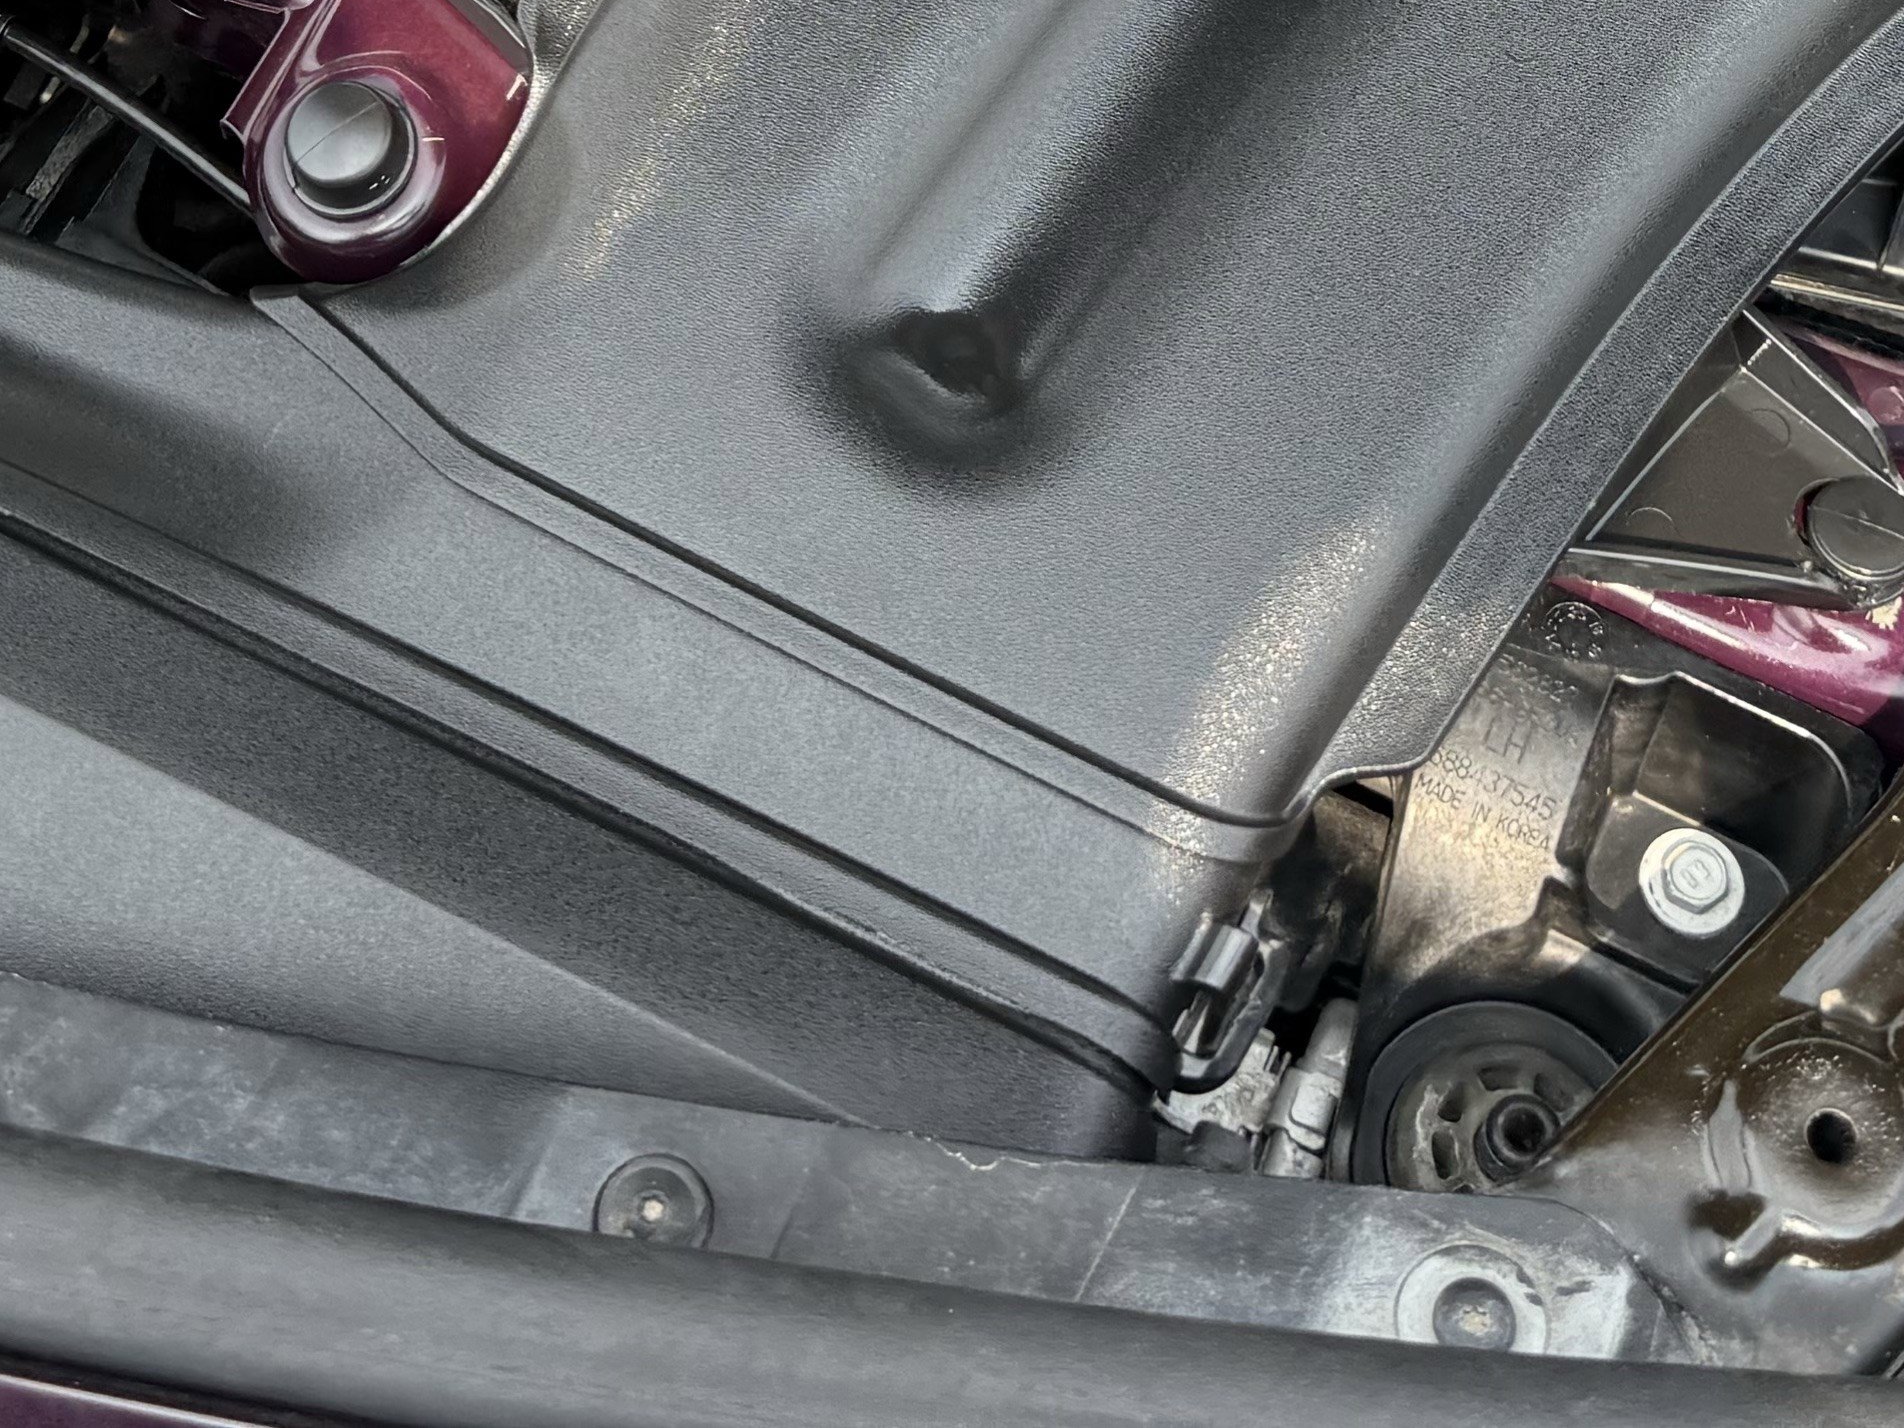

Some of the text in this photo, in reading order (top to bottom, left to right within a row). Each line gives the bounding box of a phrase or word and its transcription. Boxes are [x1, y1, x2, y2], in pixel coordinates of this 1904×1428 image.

[1415, 773, 1551, 850] MADE IN KOREA
